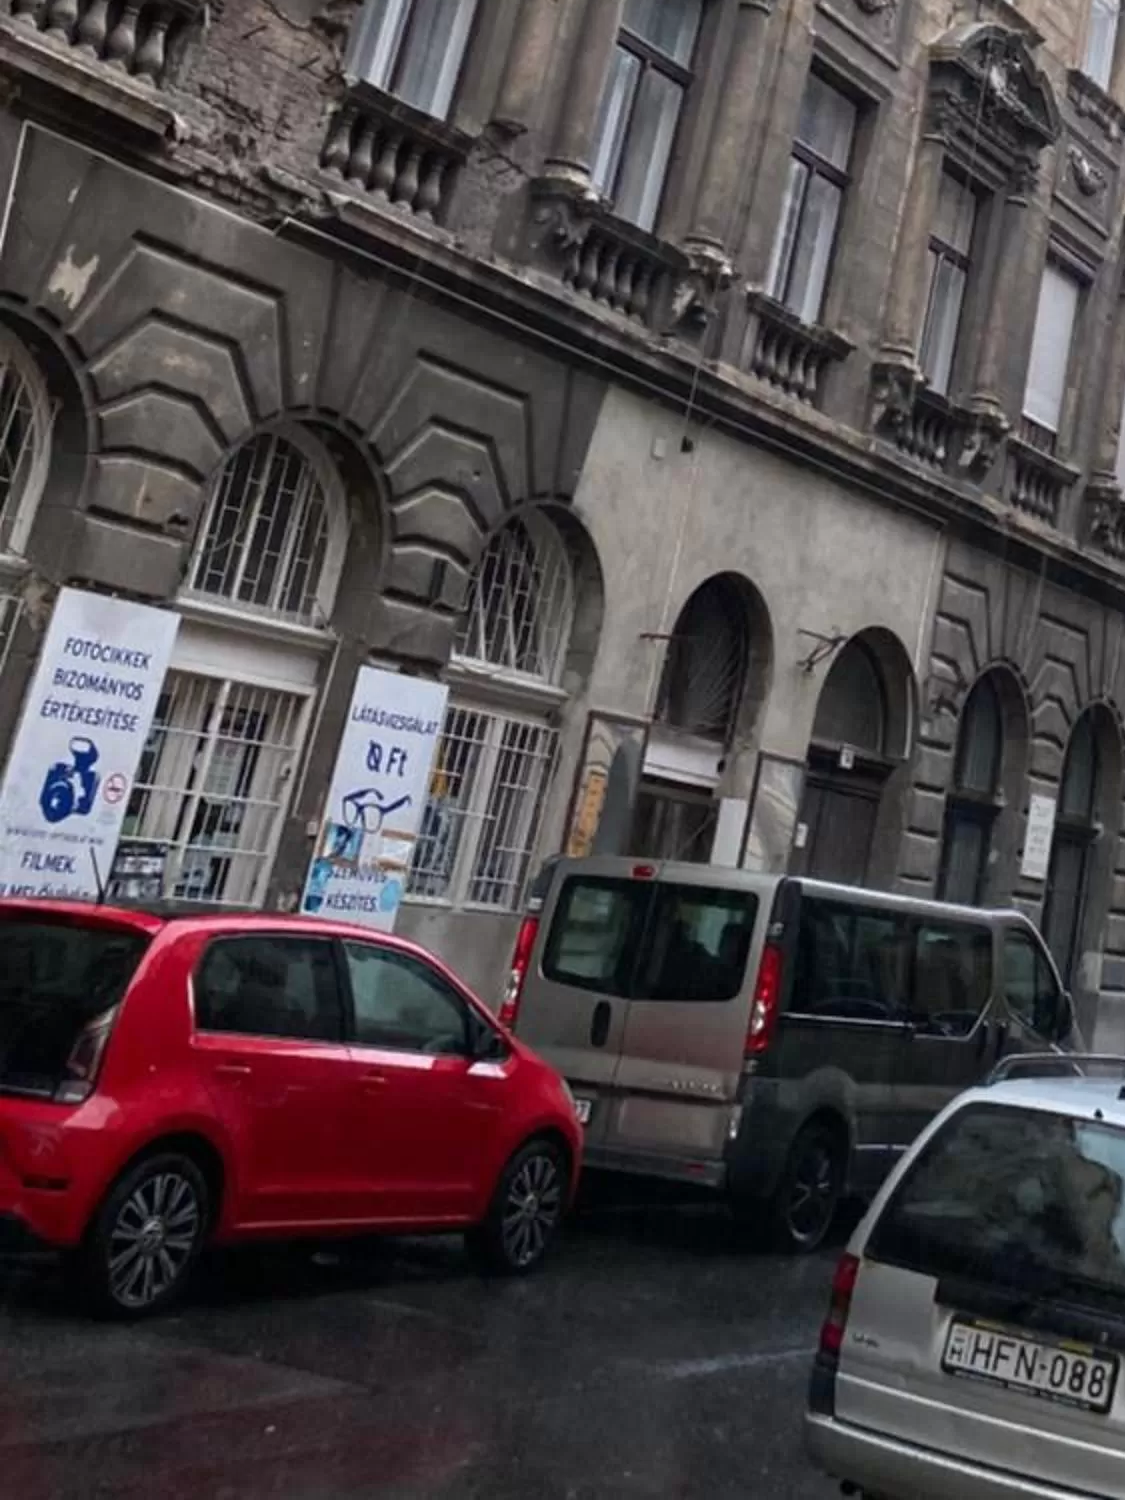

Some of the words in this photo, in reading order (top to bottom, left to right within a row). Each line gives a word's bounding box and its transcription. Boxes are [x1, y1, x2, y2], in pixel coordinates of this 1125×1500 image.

[64, 637, 152, 671] FOTÓCIKKEK
[52, 668, 144, 702] BIZOMÁNYOS
[40, 695, 139, 732] ÉRTÉKESÍTÉSE
[969, 1333, 1105, 1397] HFN-088
